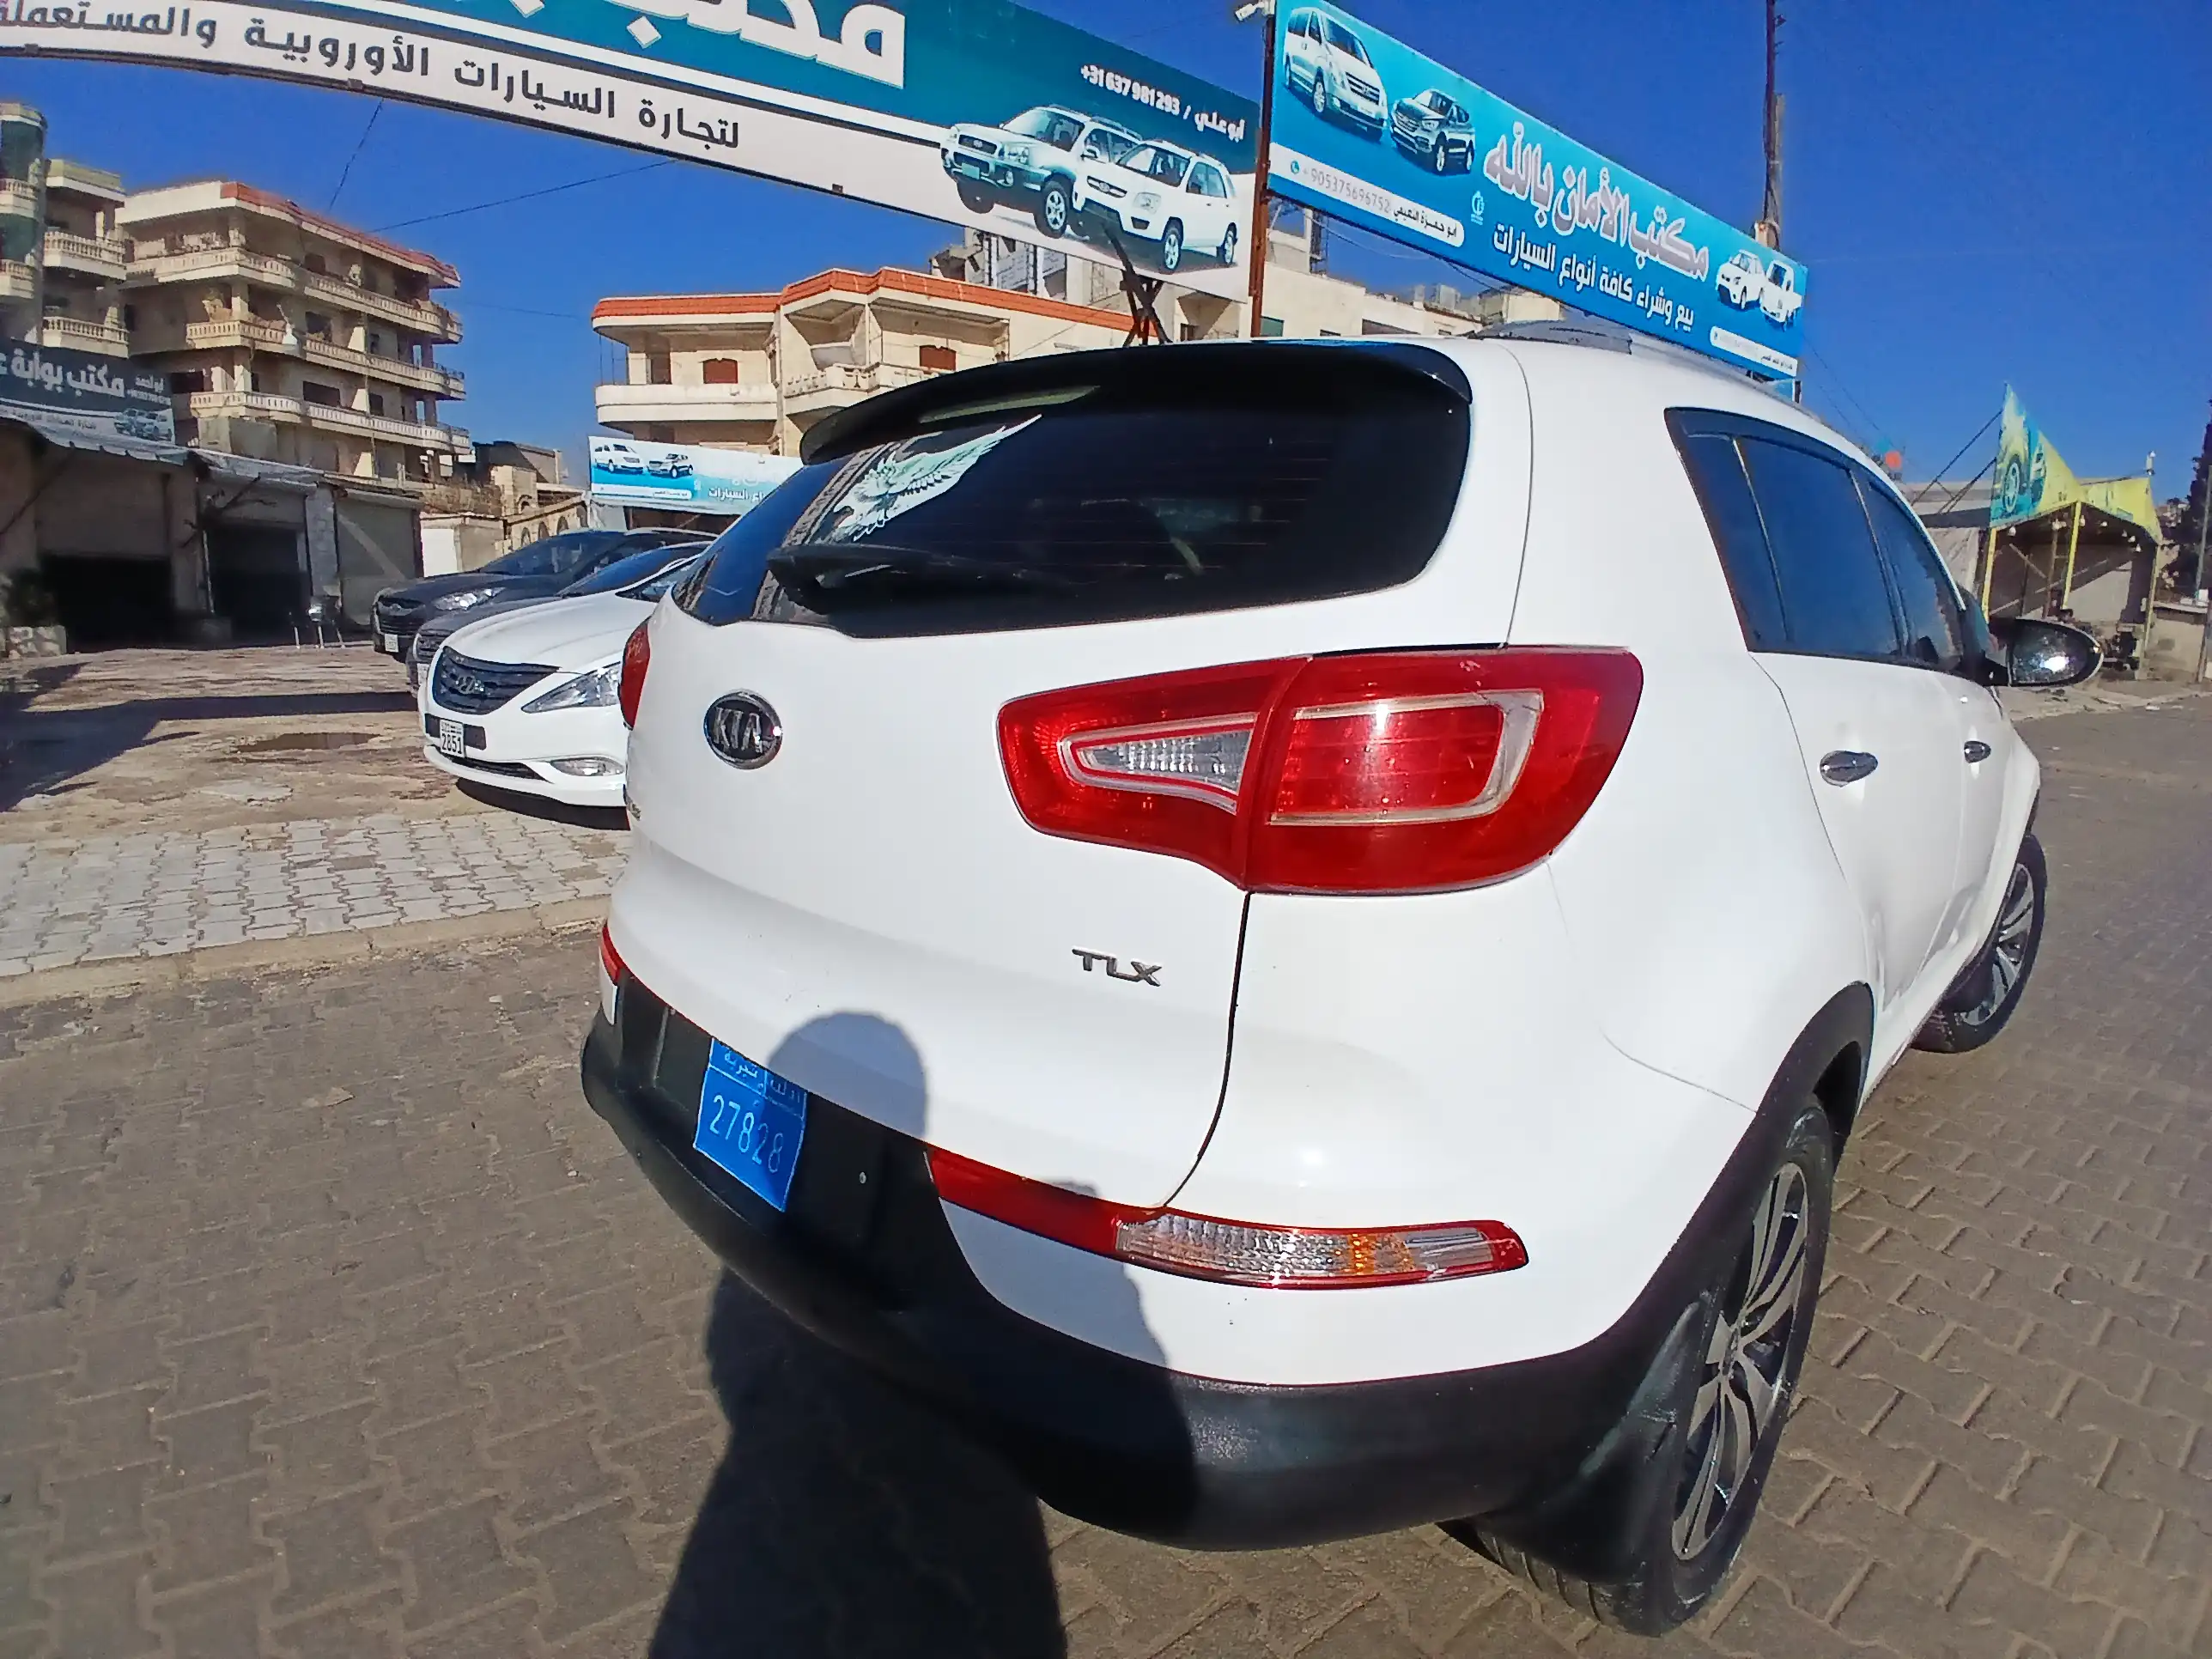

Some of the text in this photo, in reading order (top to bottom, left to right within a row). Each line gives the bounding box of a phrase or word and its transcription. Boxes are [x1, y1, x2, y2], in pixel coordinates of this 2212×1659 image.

[244, 17, 428, 76] الأوروبية
[454, 59, 616, 118] السيارات
[638, 99, 739, 150] لتجارة
[1553, 166, 1630, 247] الأمان
[1629, 206, 1710, 283] مكتب
[1492, 222, 1695, 332] بيع وشراء كافة أنواع السيارات
[66, 362, 125, 398] مكتب
[441, 732, 462, 754] 2851
[1072, 948, 1163, 987] TLX
[709, 1095, 784, 1173] 27828
